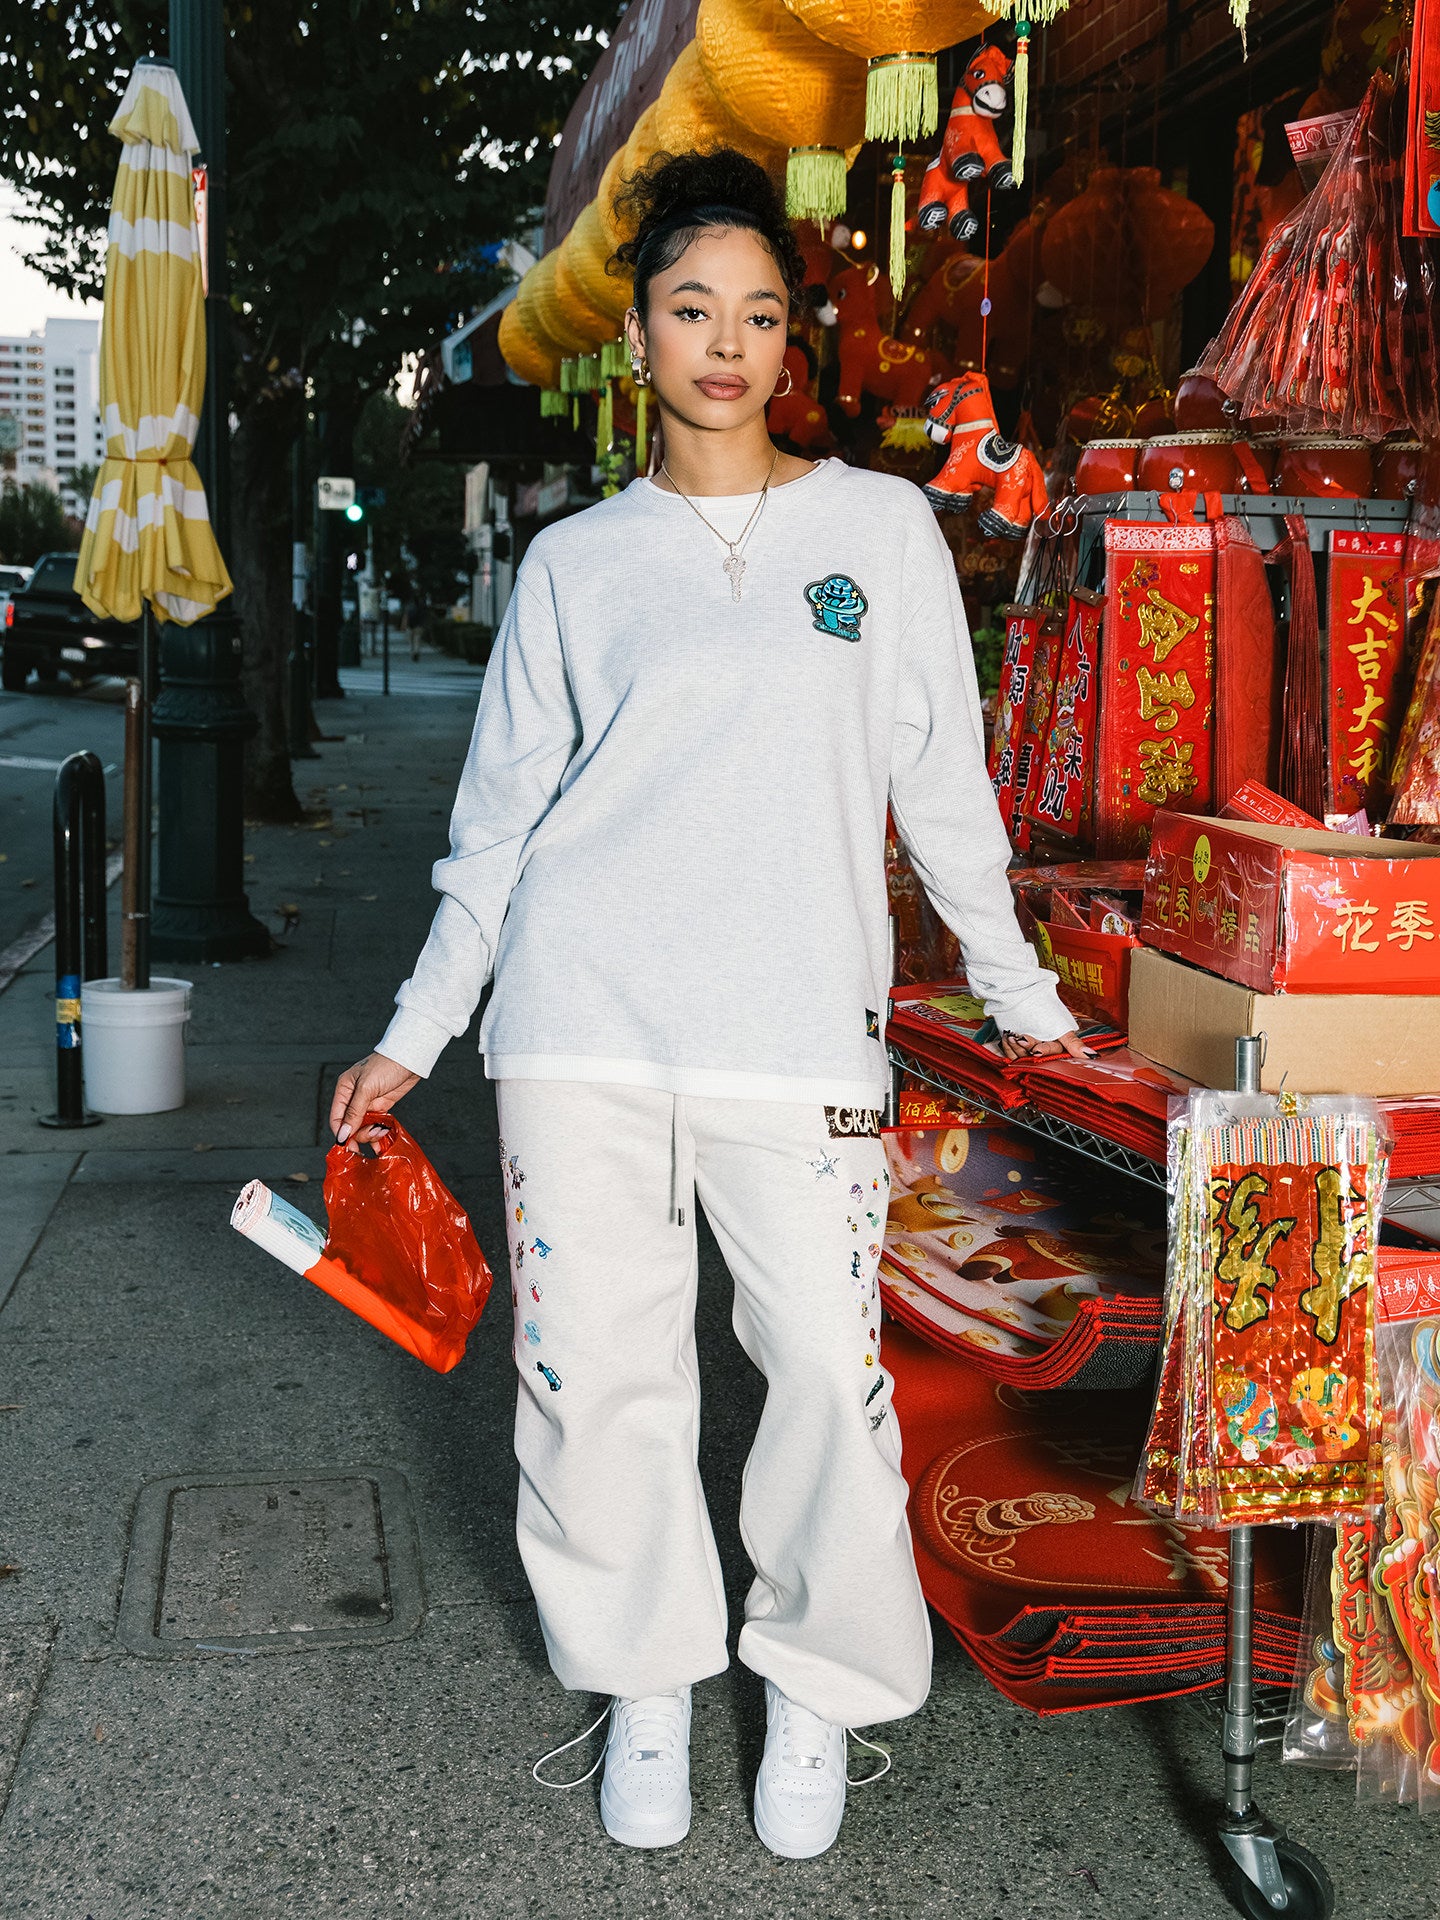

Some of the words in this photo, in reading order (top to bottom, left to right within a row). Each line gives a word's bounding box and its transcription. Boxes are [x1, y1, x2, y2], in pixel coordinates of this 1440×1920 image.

[1346, 575, 1391, 785] 大吉大利
[1155, 881, 1190, 928] 花季
[1332, 899, 1440, 953] 花季
[834, 1106, 880, 1134] GRA
[900, 1101, 940, 1118] 佰盛
